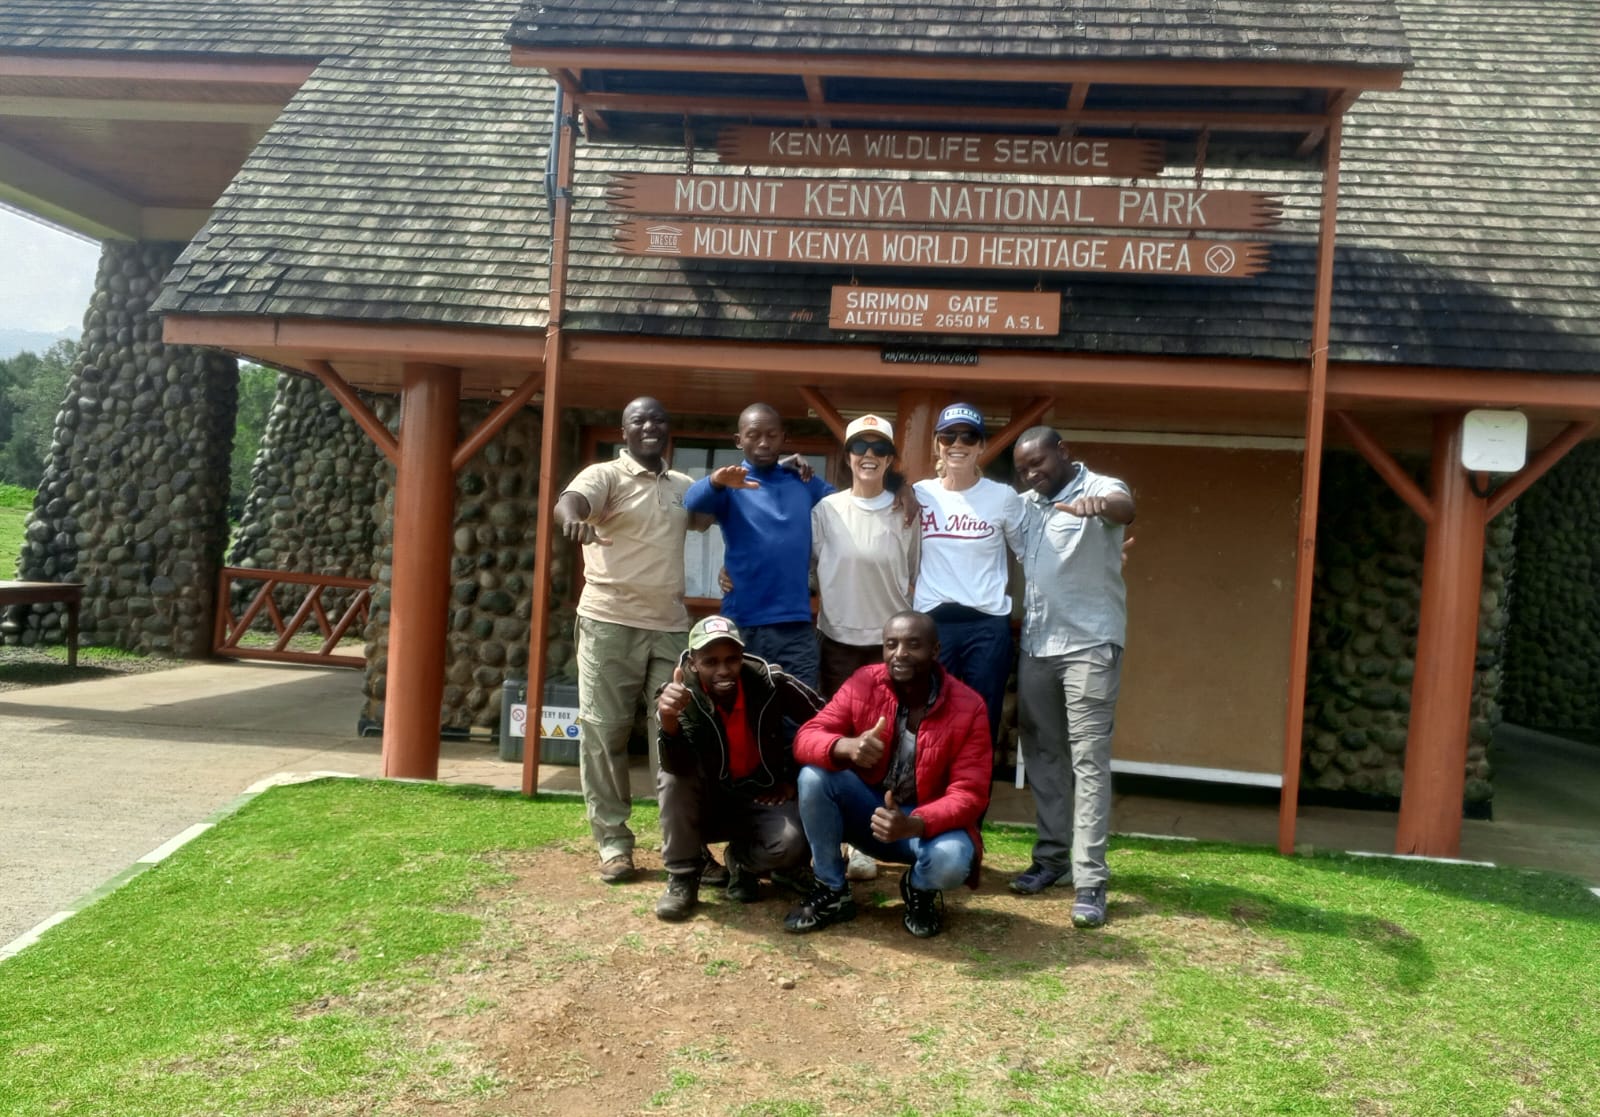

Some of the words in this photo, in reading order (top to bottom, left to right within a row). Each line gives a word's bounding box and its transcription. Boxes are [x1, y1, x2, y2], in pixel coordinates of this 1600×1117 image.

[769, 131, 851, 157] KENYA
[864, 134, 981, 162] WILDLIFE
[994, 139, 1109, 167] SERVICE
[674, 179, 783, 214] MOUNT
[803, 182, 906, 218] KENYA
[929, 186, 1094, 222] NATIONAL
[1118, 190, 1208, 225] PARK
[650, 233, 678, 246] UNESCO
[693, 226, 777, 257] MOUNT
[788, 230, 869, 261] KENYA
[881, 233, 968, 264] WORLD
[979, 236, 1109, 268] HERITAGE
[1119, 241, 1192, 272] AREA
[846, 292, 929, 311] SIRIMON
[948, 295, 999, 313] GATE
[844, 311, 924, 327] ALTITUDE
[935, 314, 973, 328] 2650
